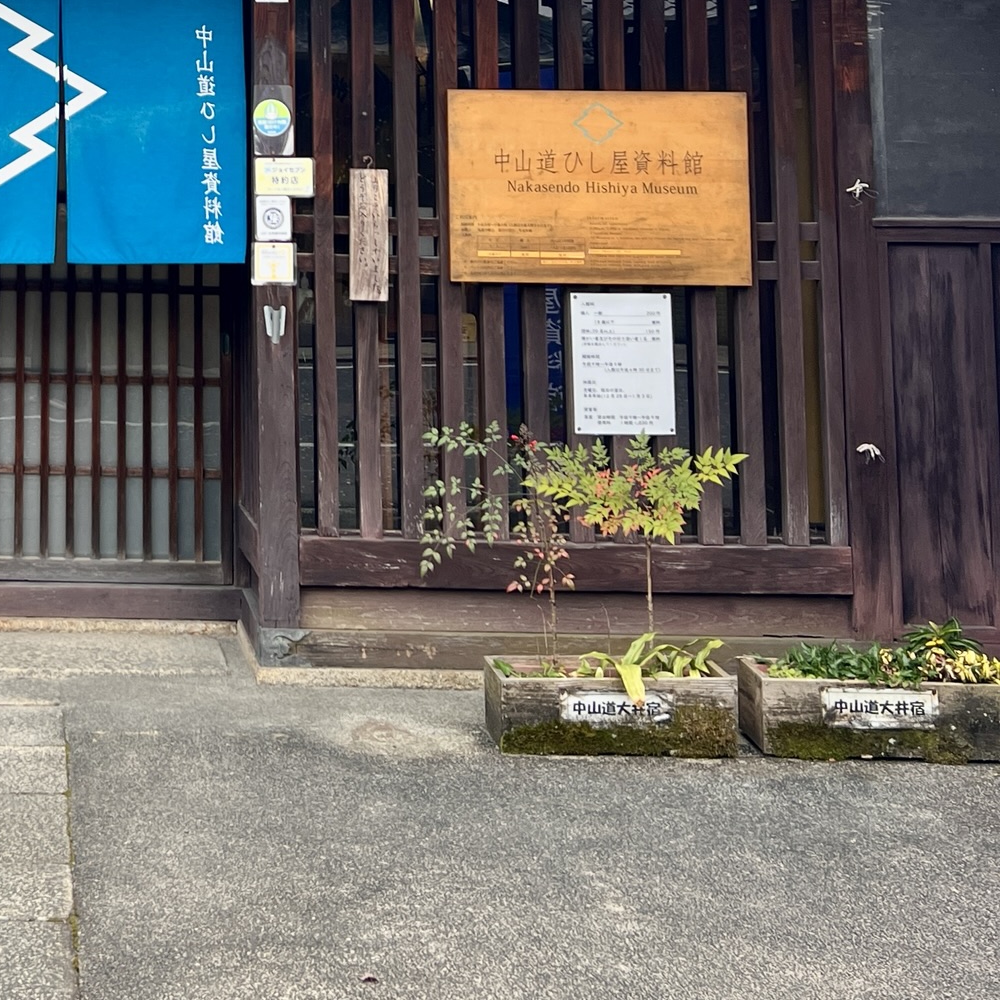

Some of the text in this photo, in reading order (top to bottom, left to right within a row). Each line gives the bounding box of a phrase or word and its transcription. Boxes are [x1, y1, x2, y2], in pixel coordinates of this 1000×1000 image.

[494, 148, 704, 176] 中山道ひし屋資料館
[507, 180, 698, 197] Nakasendo Hishiya Museum
[573, 701, 660, 715] 中山道大井宿
[834, 699, 925, 715] 中山道大井宿
